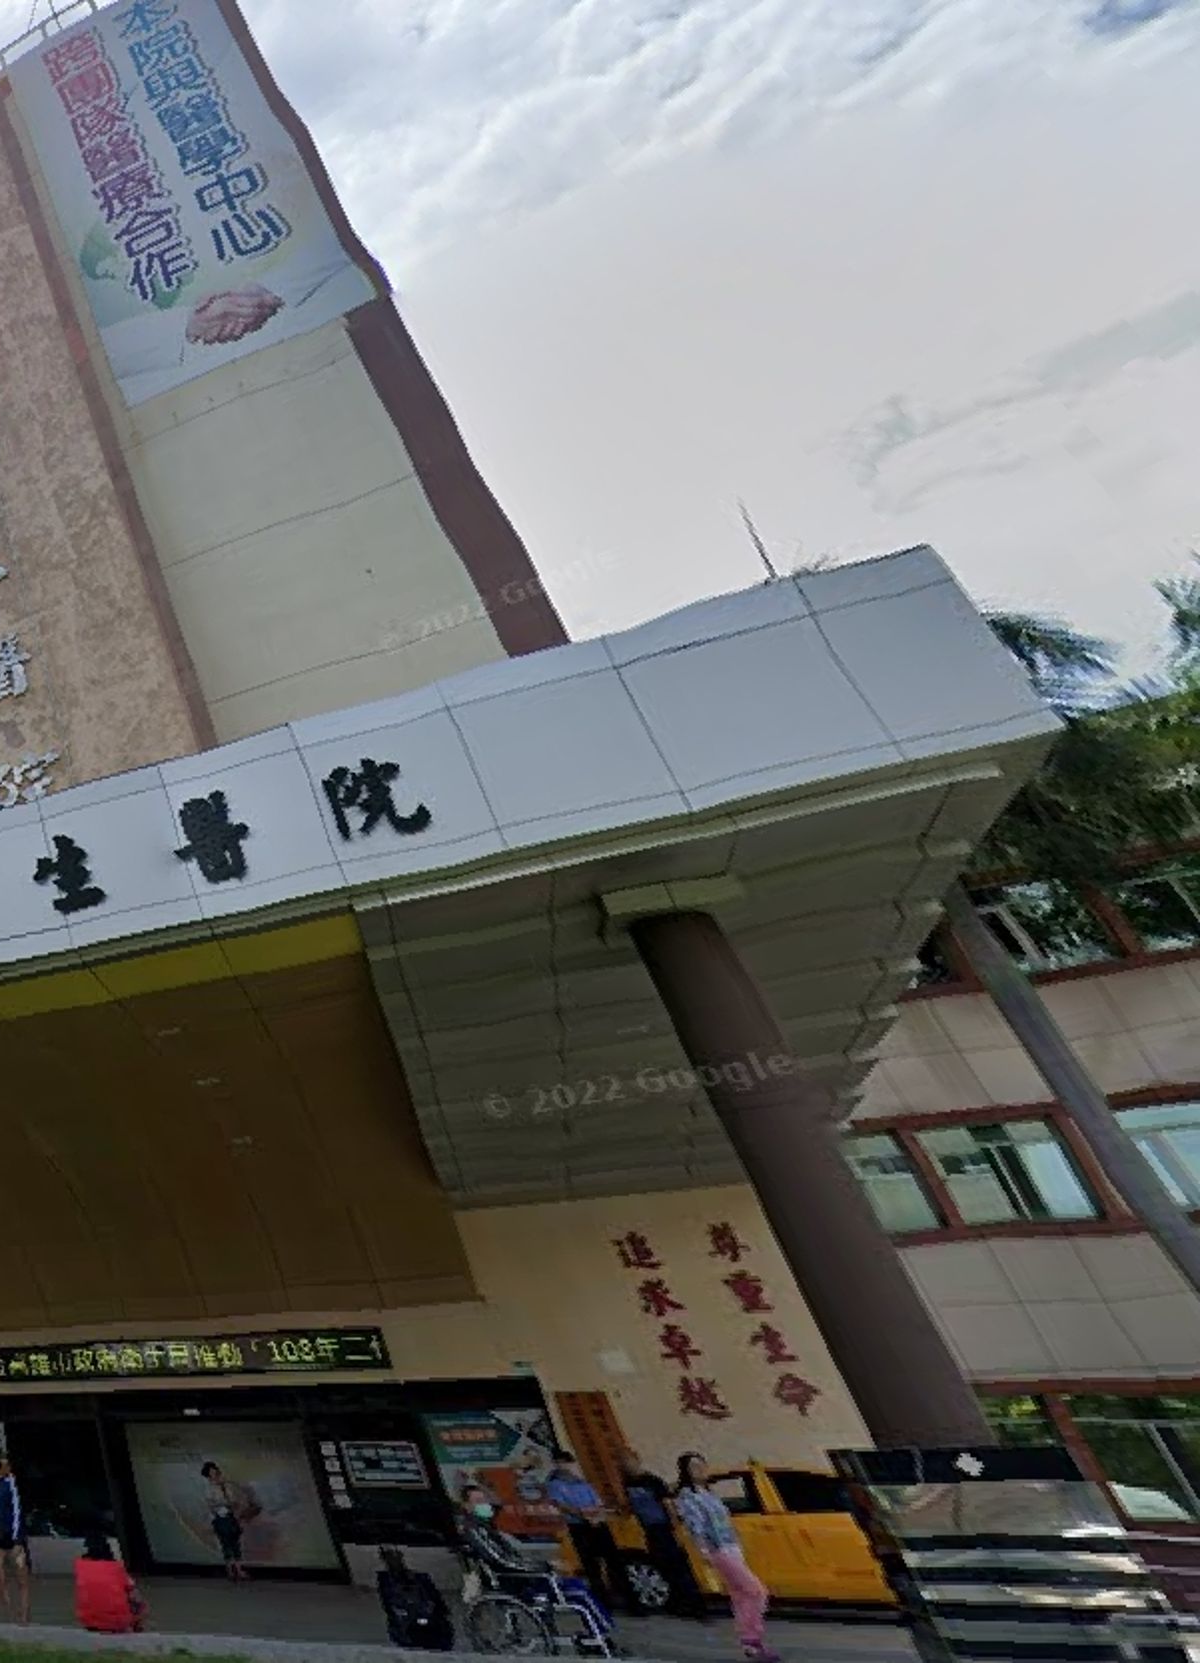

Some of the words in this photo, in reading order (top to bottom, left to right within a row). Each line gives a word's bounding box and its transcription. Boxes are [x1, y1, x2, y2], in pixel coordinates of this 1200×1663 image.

[611, 1231, 731, 1420] 追求卓越
[706, 1221, 821, 1416] 尊重生命
